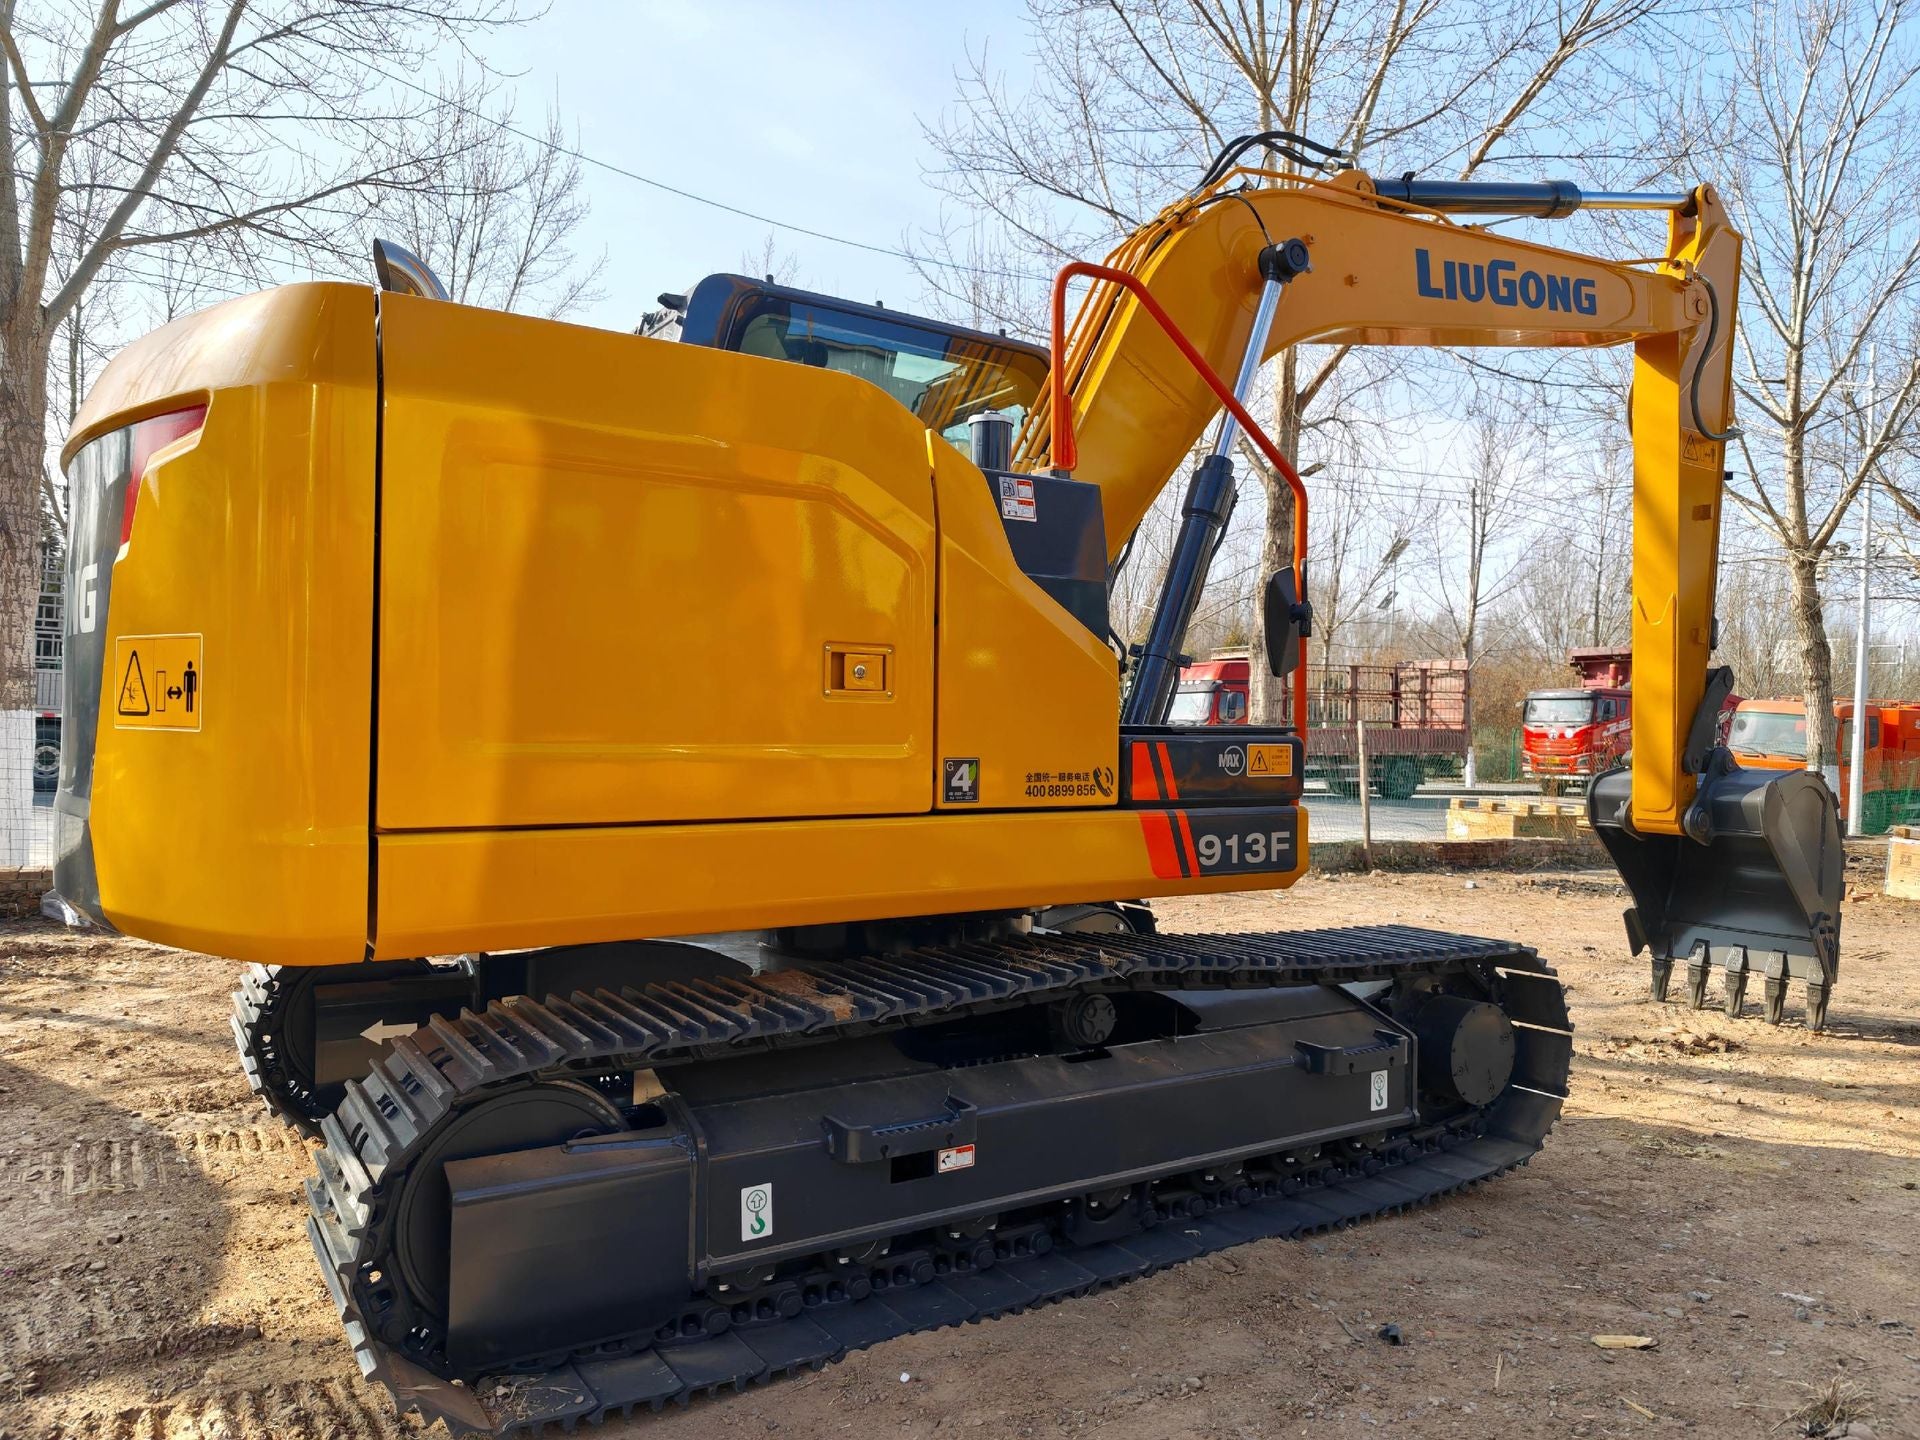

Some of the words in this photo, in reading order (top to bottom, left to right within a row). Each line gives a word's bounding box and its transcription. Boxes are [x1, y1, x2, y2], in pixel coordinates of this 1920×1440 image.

[64, 563, 97, 636] NG
[1218, 753, 1240, 768] MAX
[946, 761, 954, 772] G
[951, 763, 971, 792] 4
[1025, 772, 1090, 783] 全国统一服务电话
[1198, 831, 1290, 866] 913F
